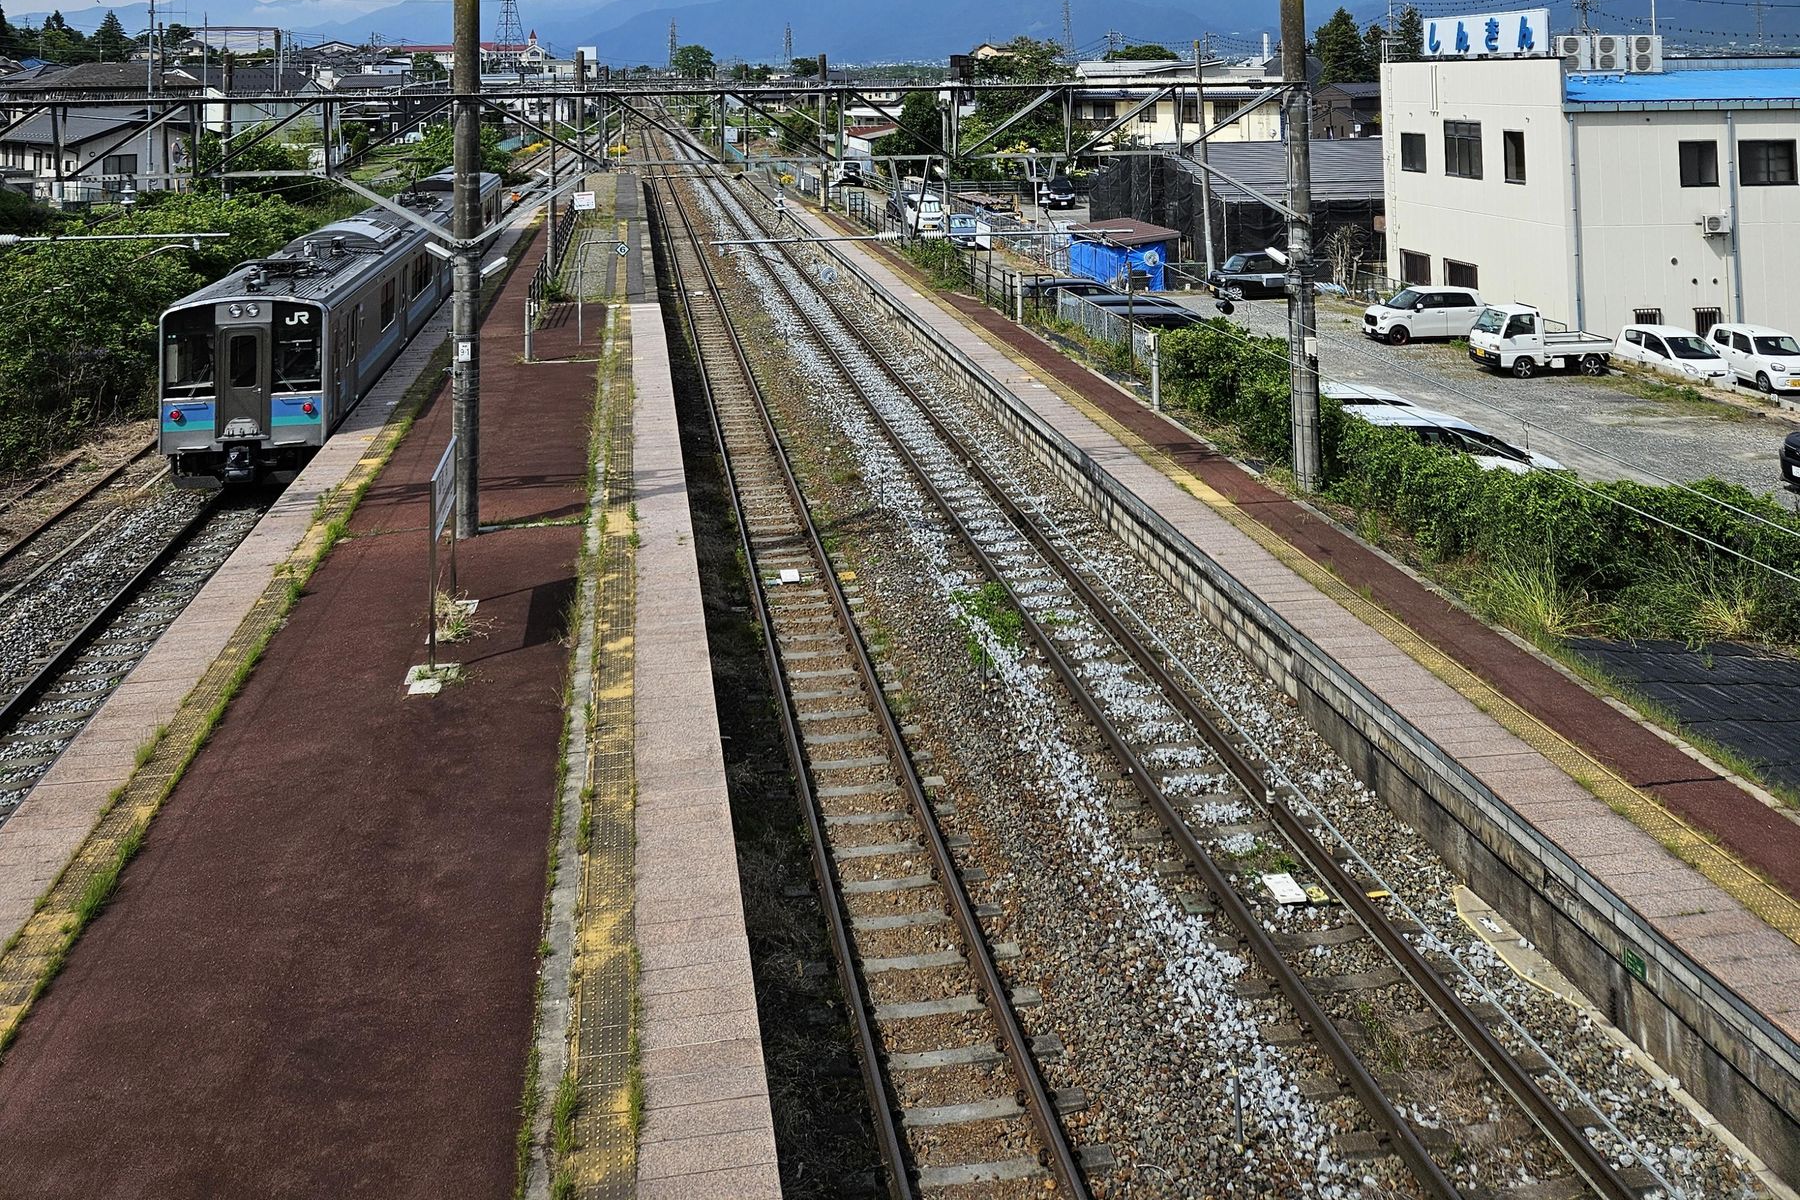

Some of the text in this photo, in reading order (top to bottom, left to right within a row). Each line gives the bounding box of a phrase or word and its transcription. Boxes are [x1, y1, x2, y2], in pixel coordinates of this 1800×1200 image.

[1428, 16, 1536, 52] しんきん
[285, 311, 310, 325] JR
